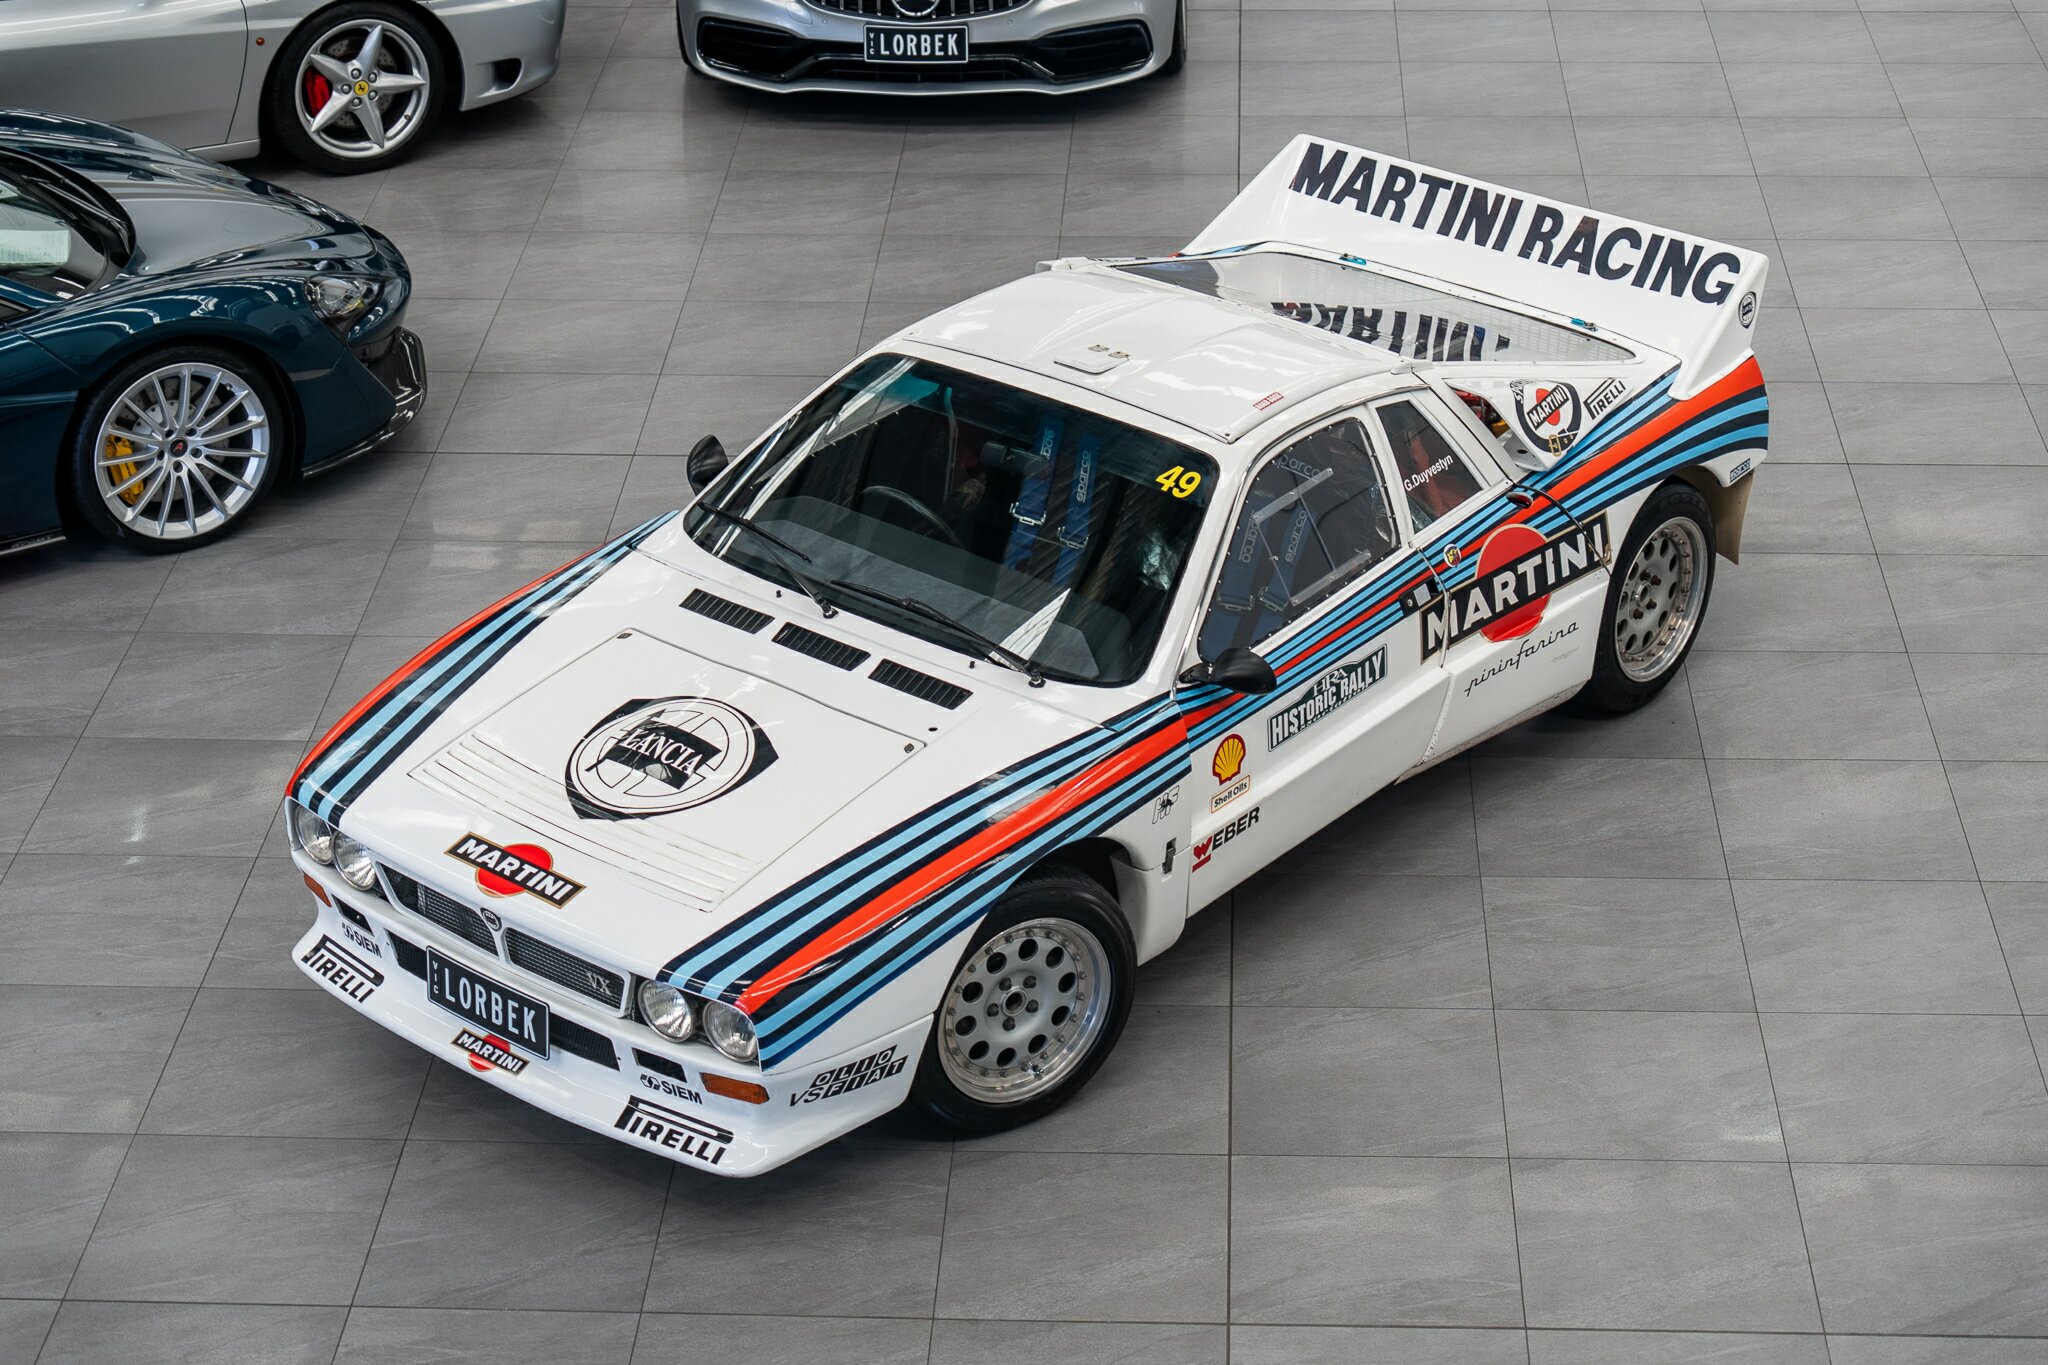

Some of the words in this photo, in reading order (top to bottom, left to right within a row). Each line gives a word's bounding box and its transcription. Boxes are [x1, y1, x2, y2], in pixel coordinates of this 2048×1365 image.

[881, 33, 959, 56] LORBEK
[1289, 142, 1523, 253] MARTINI
[1518, 204, 1741, 306] RACING
[1529, 387, 1568, 427] MARTINI
[1583, 377, 1626, 420] PIRELLI
[1155, 465, 1202, 499] 49
[1404, 454, 1454, 491] G.Duyvestyn
[1427, 523, 1605, 650] MARTINI
[1464, 621, 1579, 697] pininfarina
[1271, 685, 1337, 747] HISTORIC
[1340, 649, 1384, 699] RALLY
[1313, 668, 1349, 697] HRA
[619, 728, 704, 776] LANCIA
[1213, 789, 1232, 808] Shell
[1233, 781, 1248, 796] Oils
[1192, 806, 1260, 861] WEBER
[456, 838, 574, 900] MARTINI
[354, 931, 382, 958] SIEM
[301, 934, 385, 1004] PIRELLI
[444, 967, 537, 1043] LORBEK
[457, 1033, 523, 1072] MARTINI
[813, 1047, 895, 1087] OLIO
[661, 1080, 703, 1105] SIEM
[614, 1095, 734, 1165] PIRELLI
